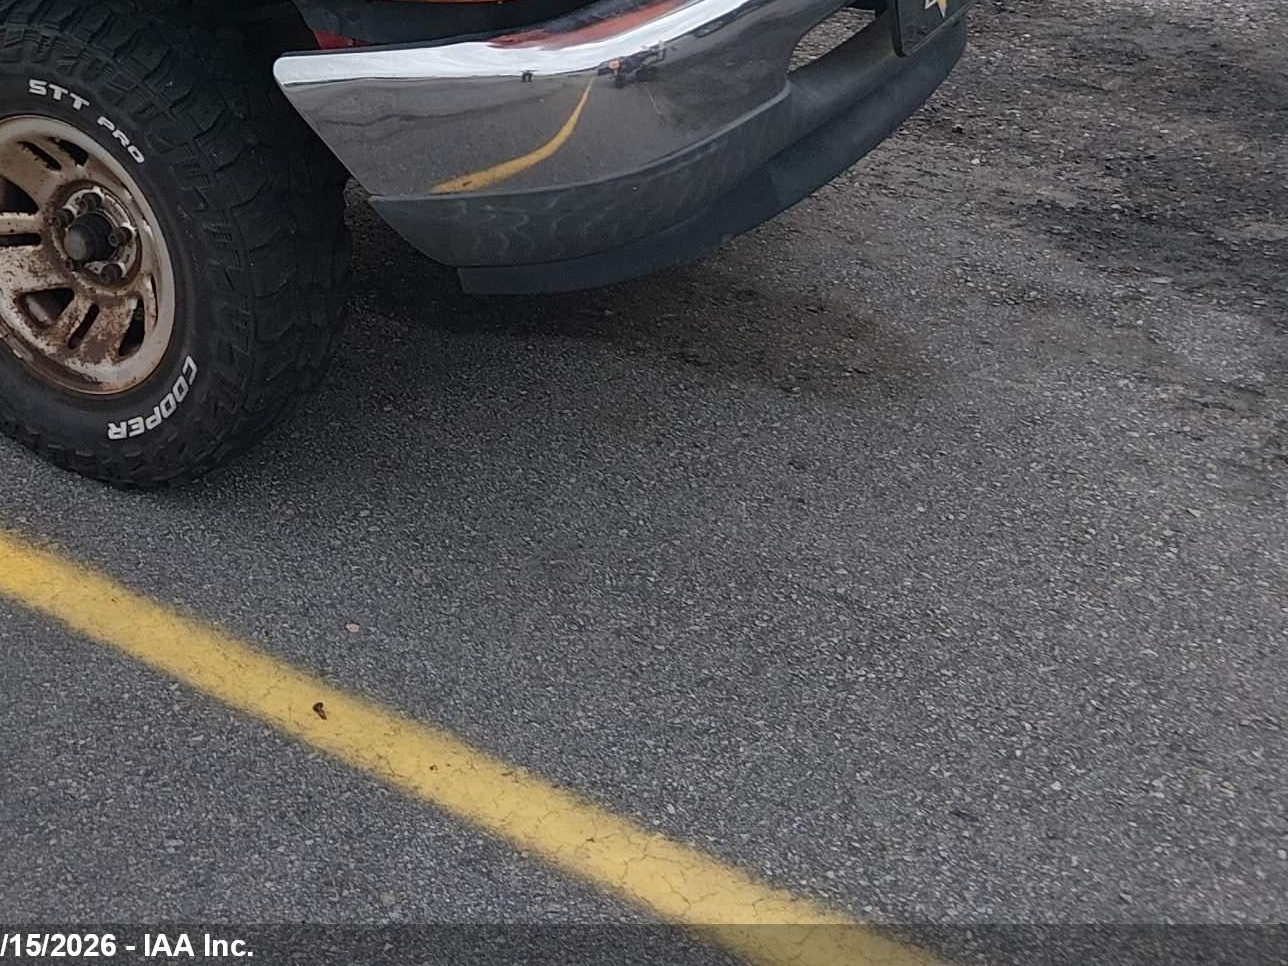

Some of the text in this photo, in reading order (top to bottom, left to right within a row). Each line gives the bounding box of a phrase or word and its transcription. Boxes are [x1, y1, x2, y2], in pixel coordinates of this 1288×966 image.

[28, 78, 145, 165] STT PRO
[107, 354, 199, 441] COOPER
